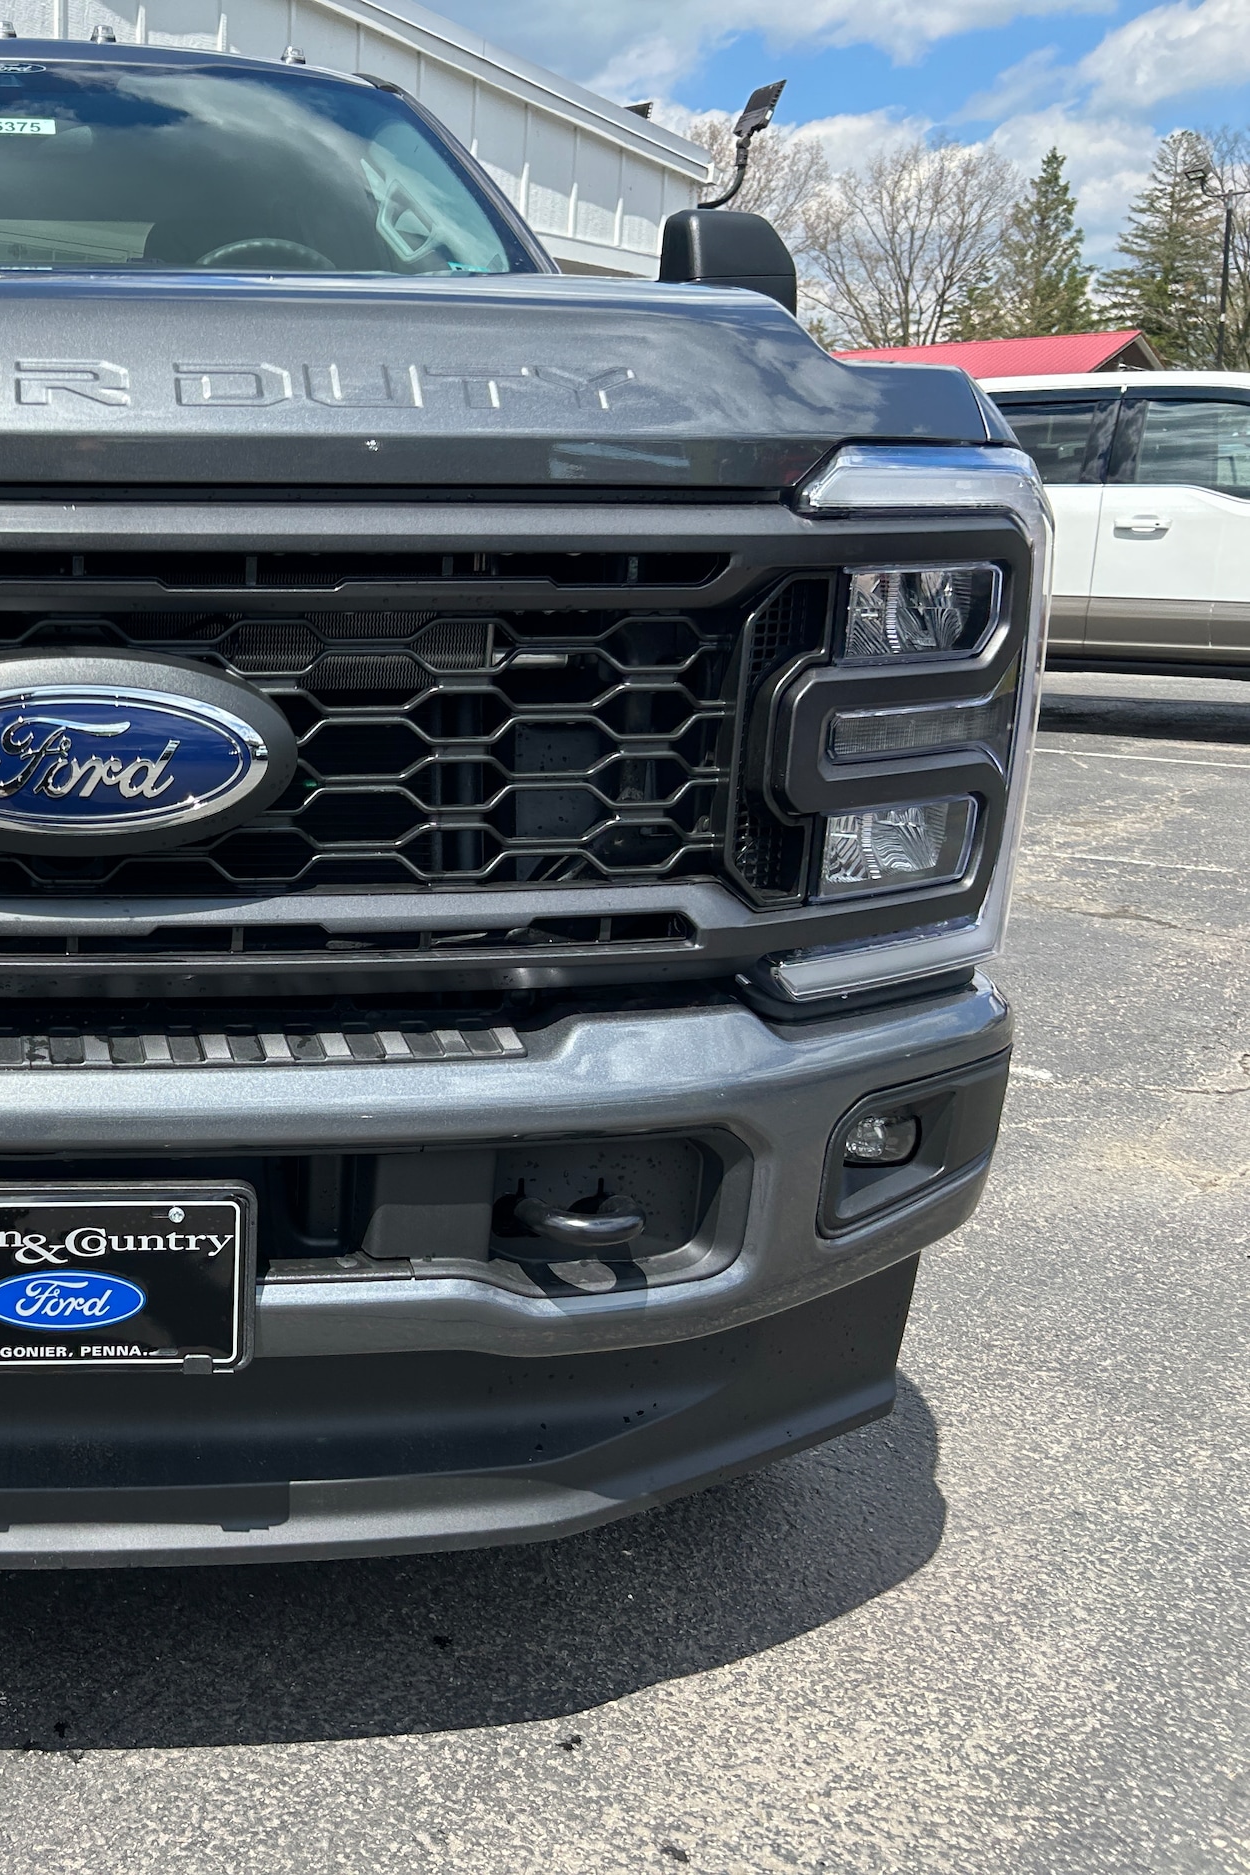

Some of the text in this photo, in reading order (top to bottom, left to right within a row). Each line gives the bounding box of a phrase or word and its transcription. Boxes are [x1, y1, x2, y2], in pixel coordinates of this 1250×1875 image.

[172, 362, 636, 410] DUTY
[15, 1280, 113, 1318] Ford
[80, 1344, 149, 1358] PENNA.
